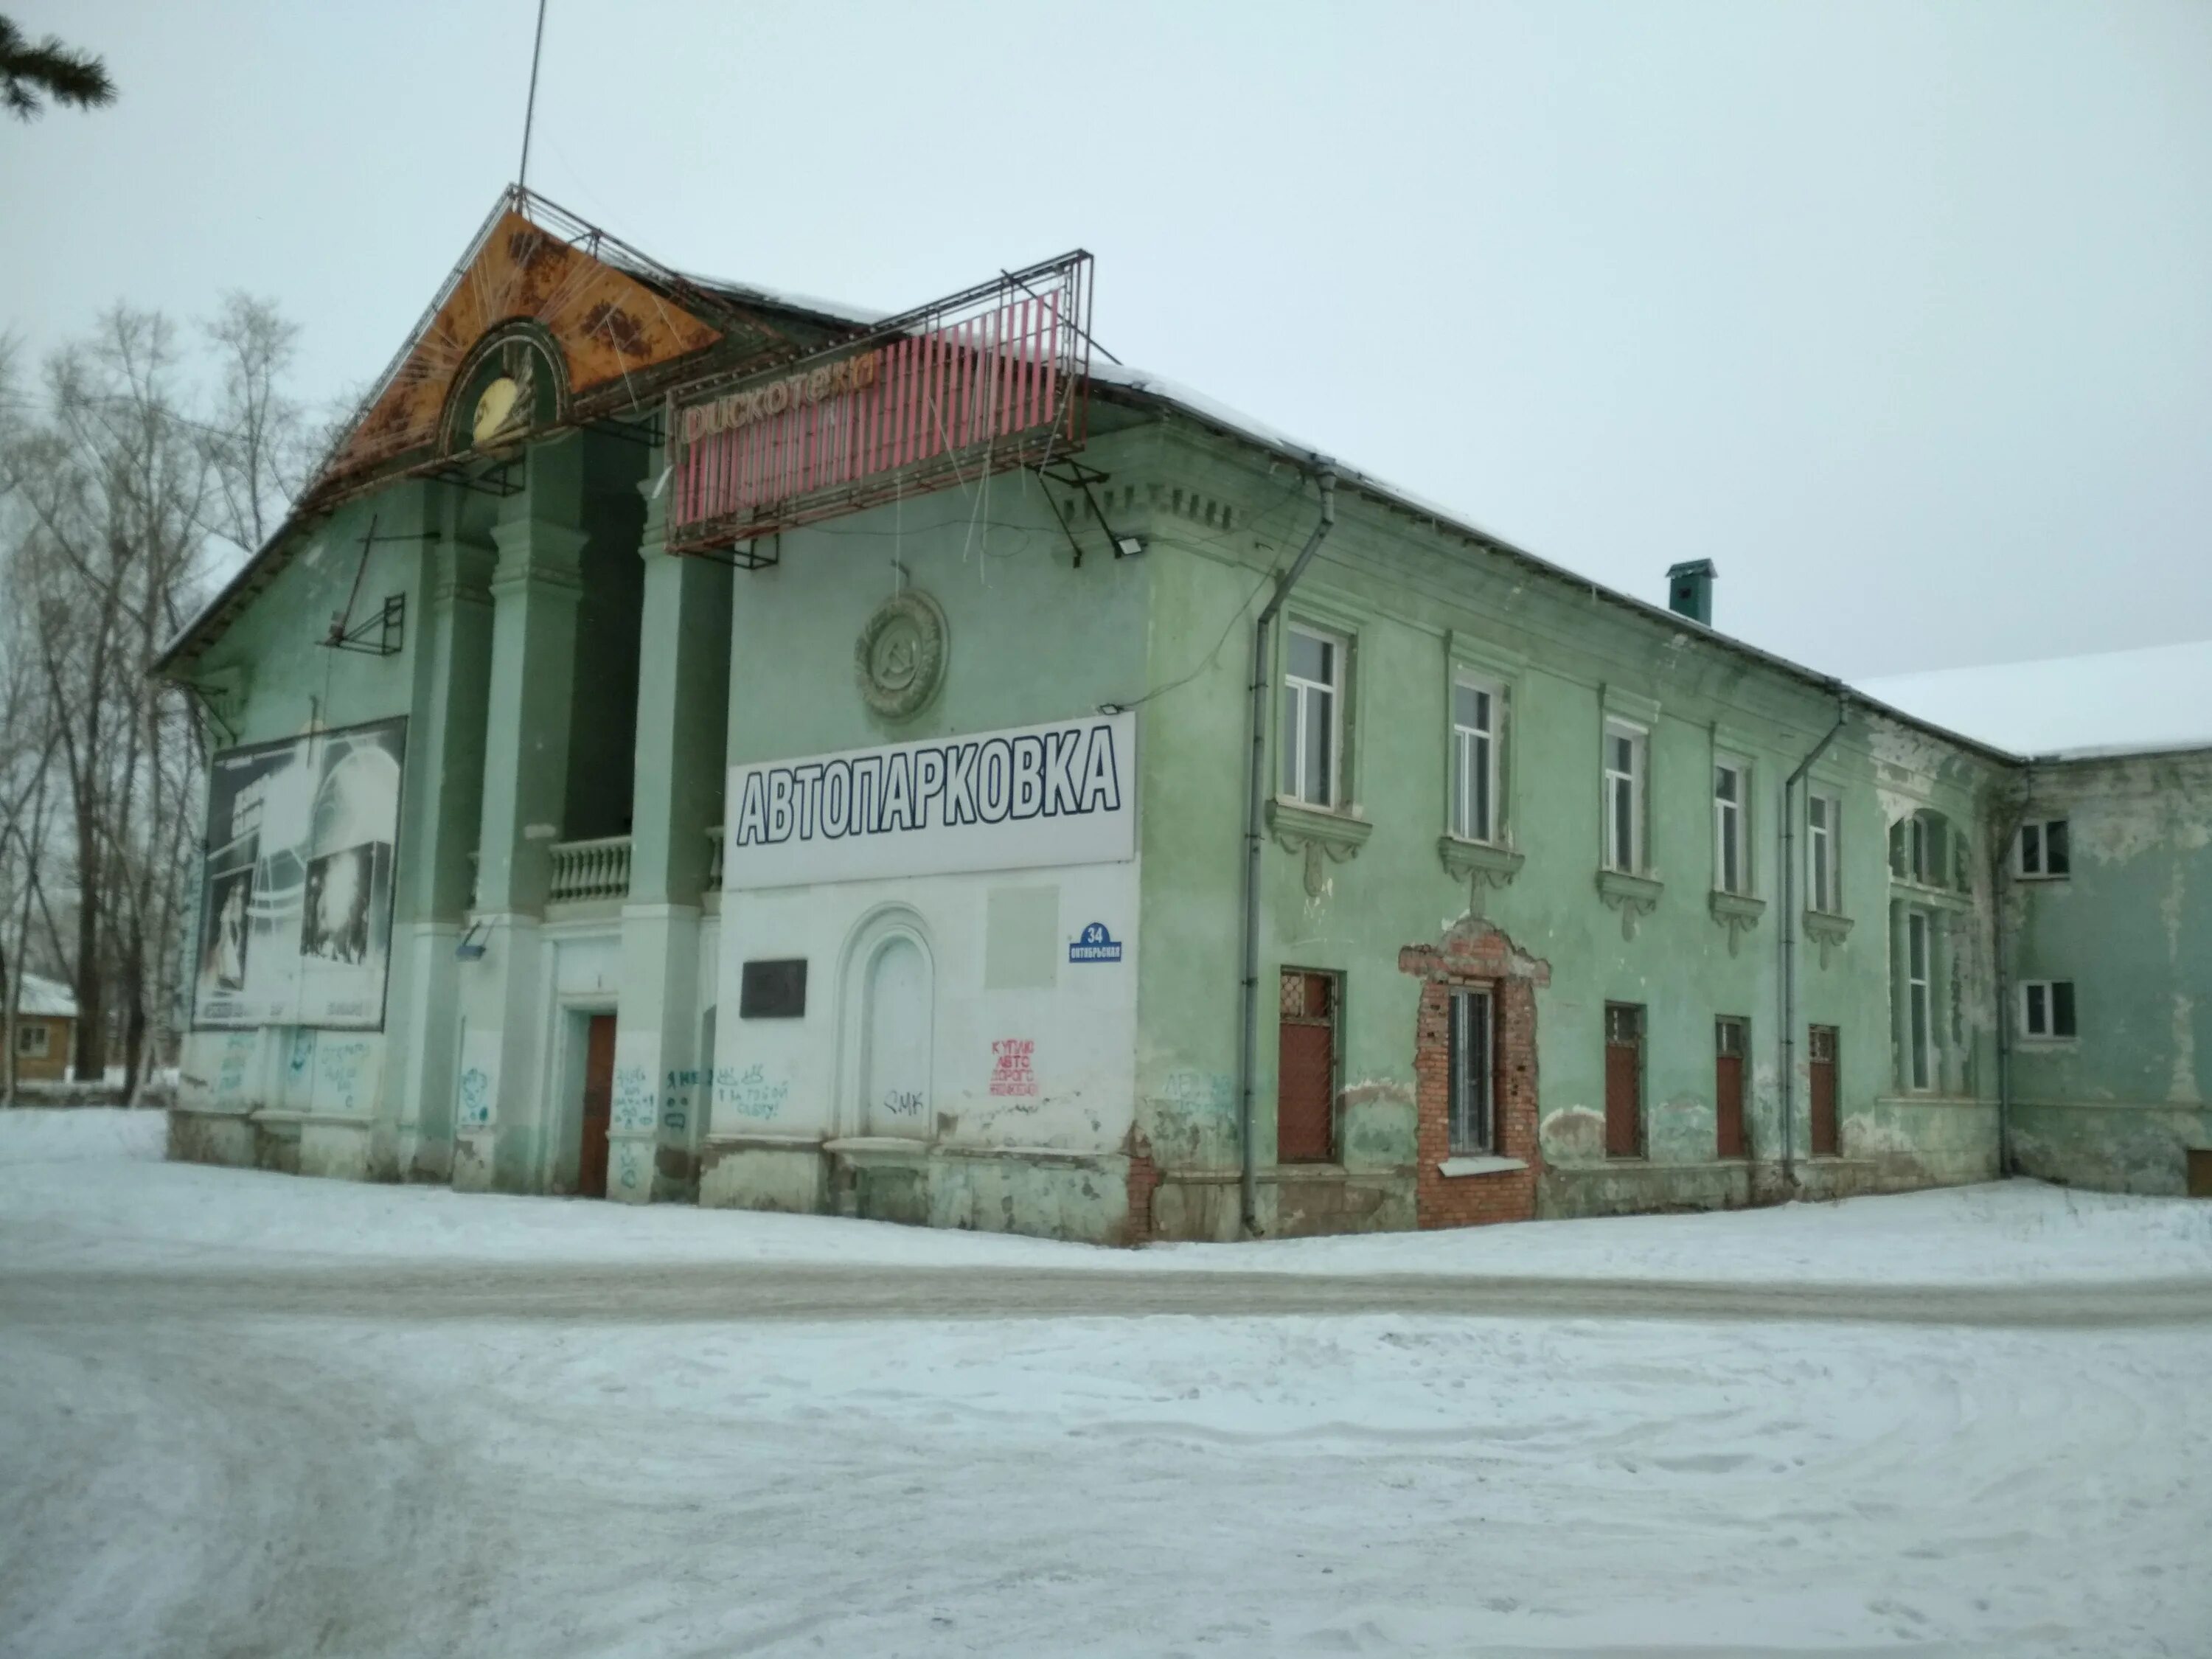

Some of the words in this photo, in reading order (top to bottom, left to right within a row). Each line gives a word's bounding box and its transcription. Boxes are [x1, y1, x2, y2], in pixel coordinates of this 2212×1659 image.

[737, 725, 1120, 846] АВТОПАРКОВКА
[1088, 927, 1103, 943] 34
[1071, 946, 1120, 959] ОКТЯБРЬСКАЯ
